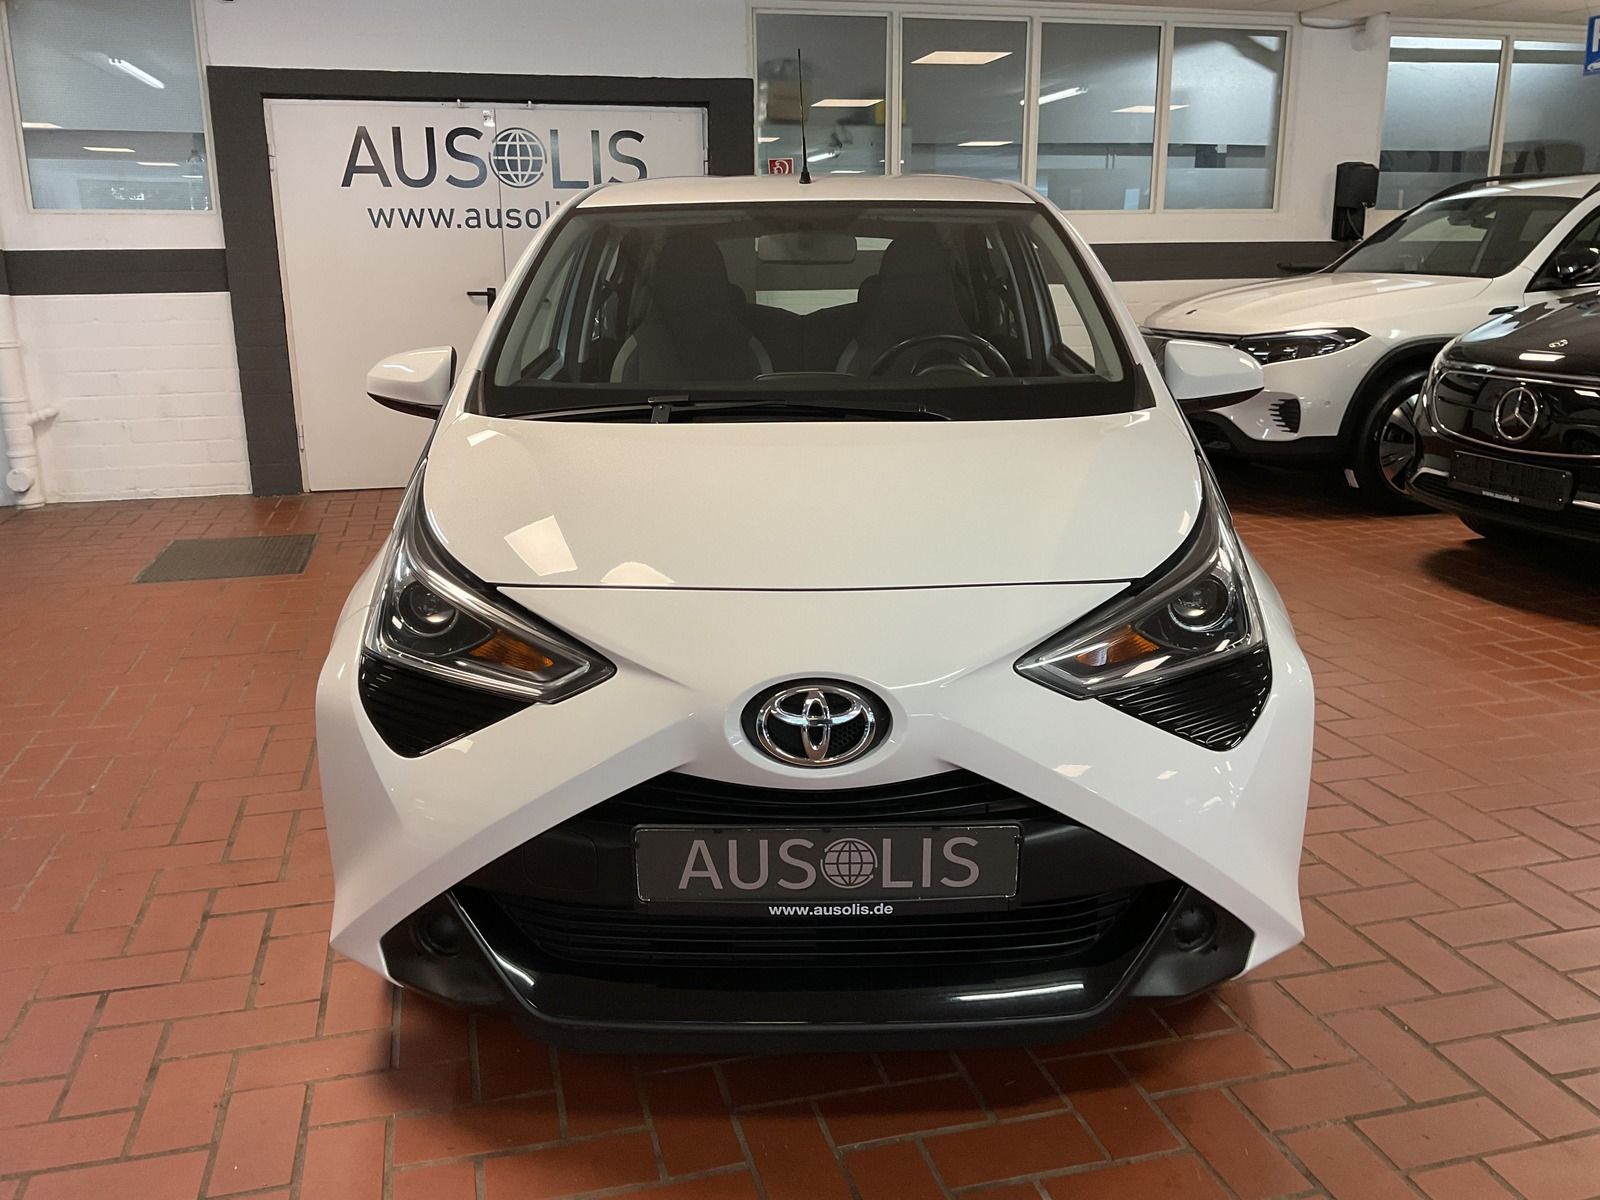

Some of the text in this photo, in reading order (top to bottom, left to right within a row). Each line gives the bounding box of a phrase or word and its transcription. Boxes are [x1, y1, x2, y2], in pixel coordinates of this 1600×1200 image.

[341, 126, 648, 189] AUSOLIS
[367, 200, 560, 229] www.ausol
[678, 836, 980, 890] AUSOLIS
[768, 903, 894, 916] www.ausolis.de
